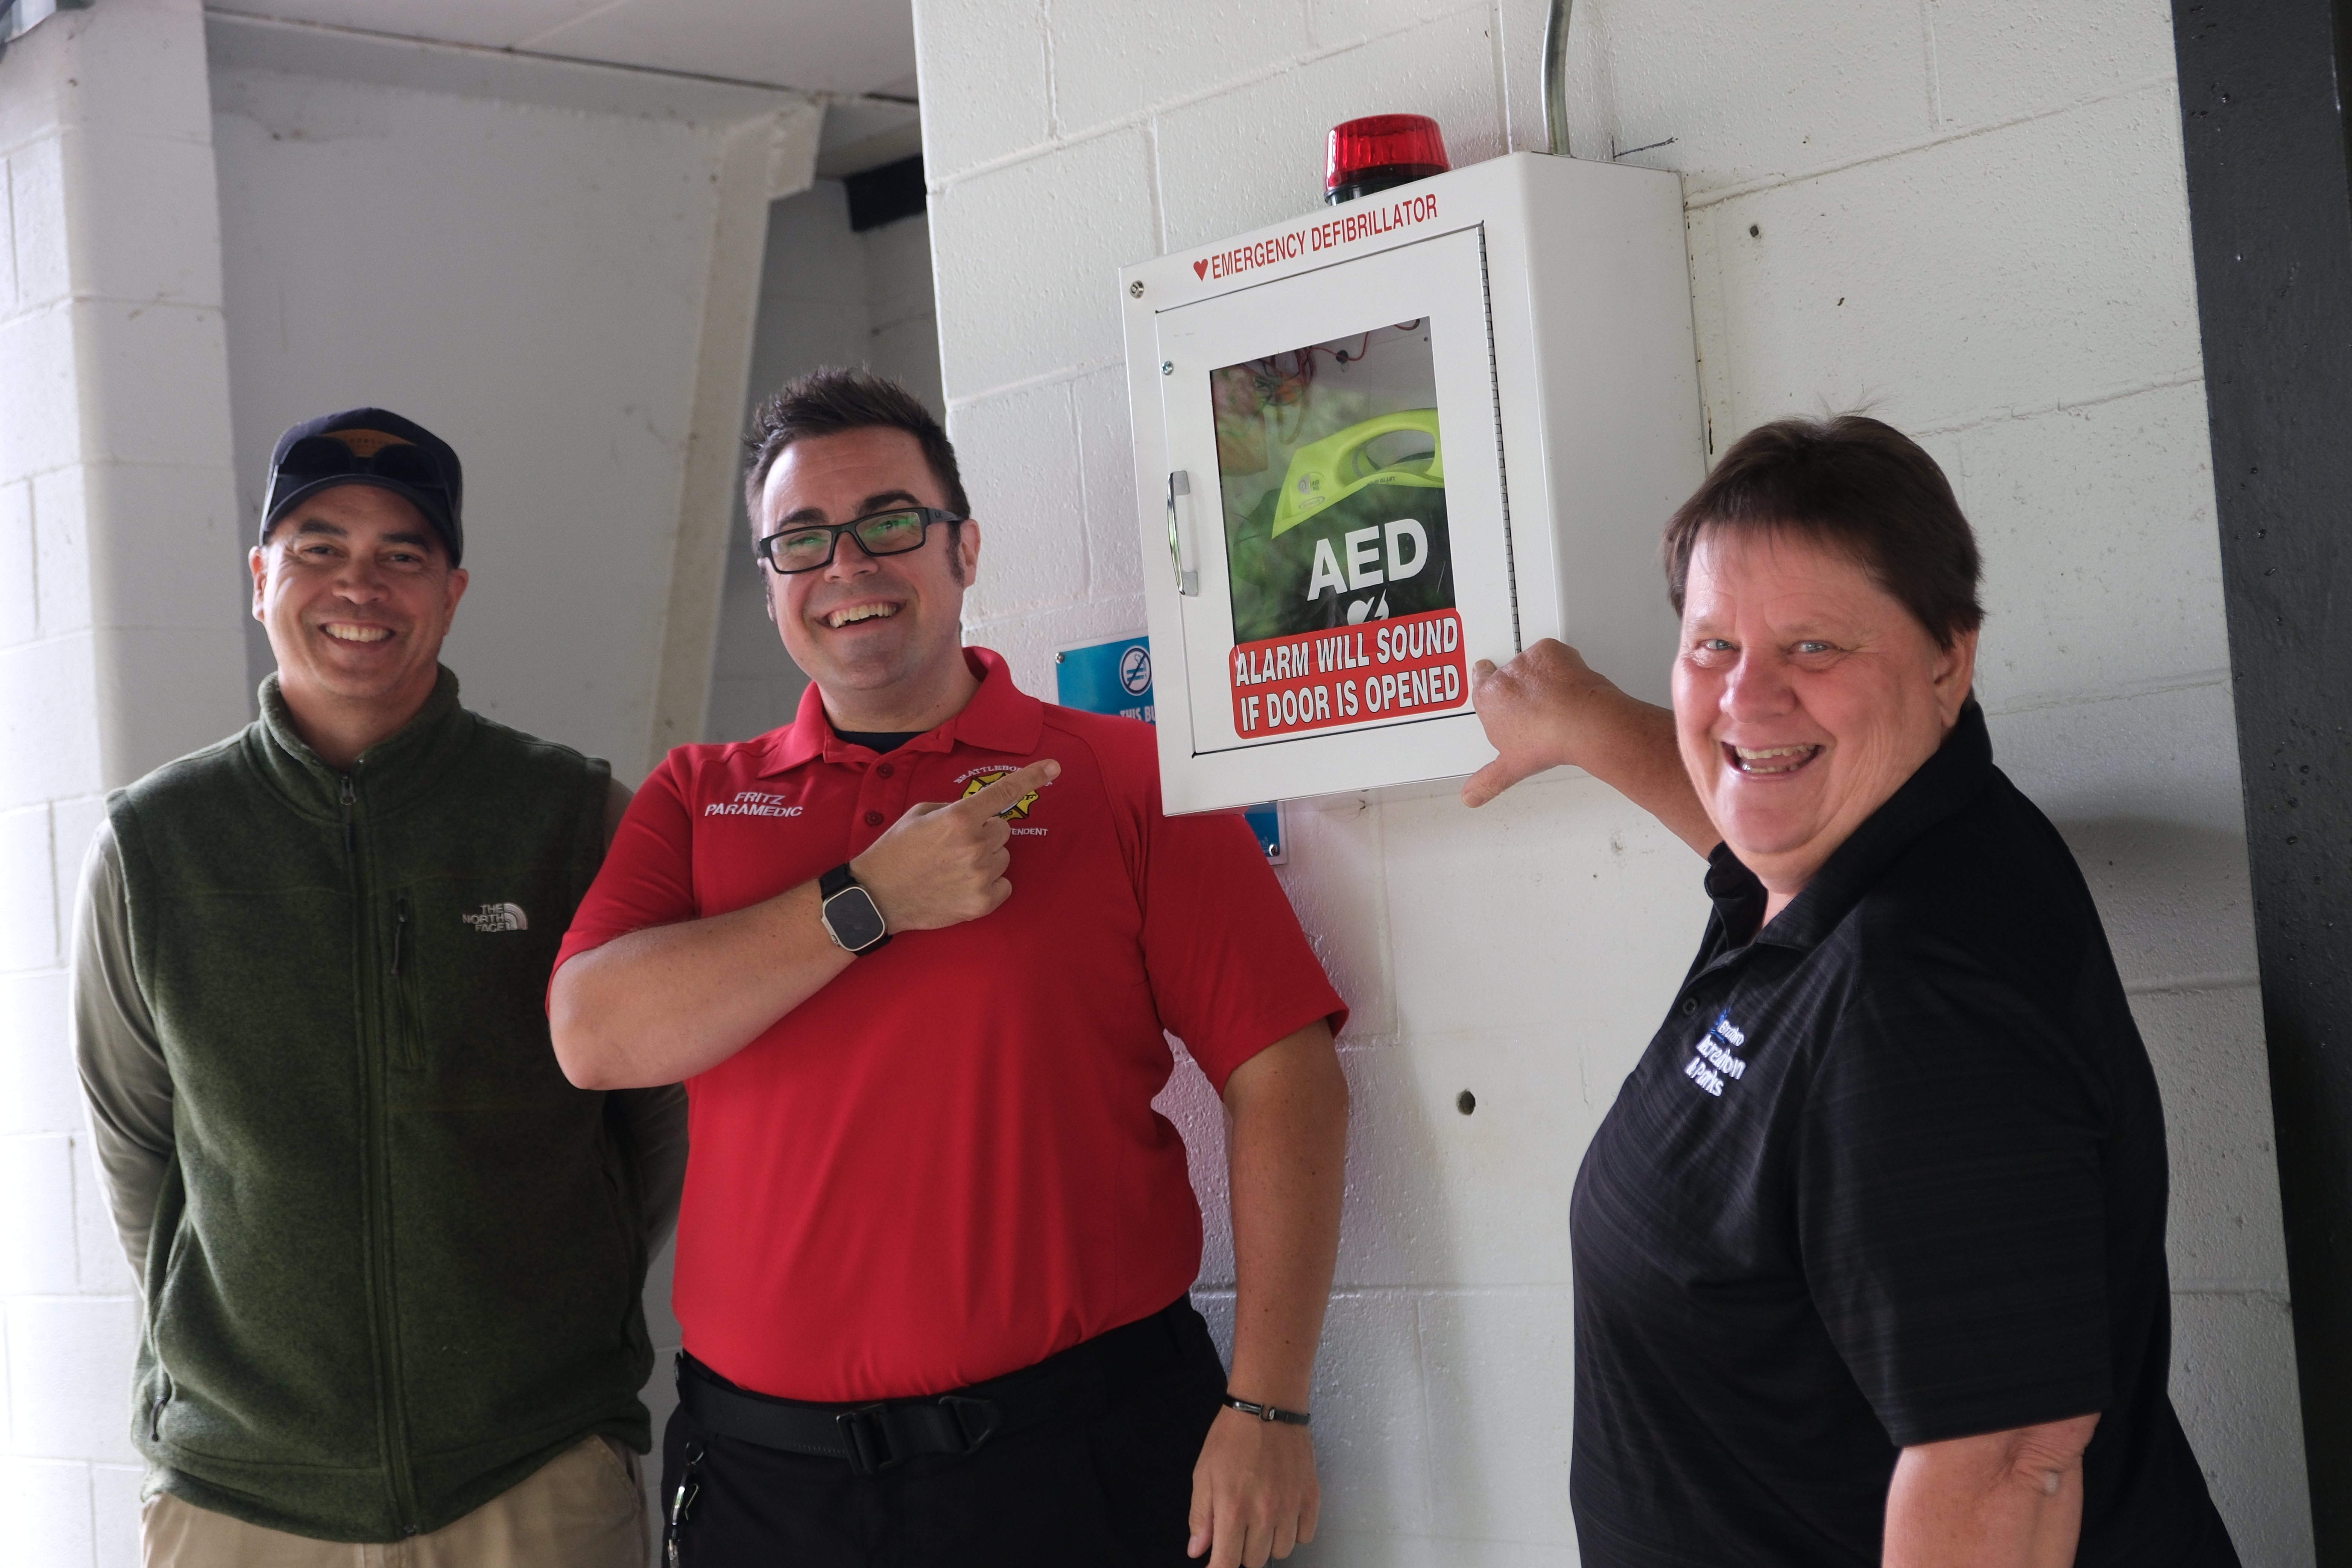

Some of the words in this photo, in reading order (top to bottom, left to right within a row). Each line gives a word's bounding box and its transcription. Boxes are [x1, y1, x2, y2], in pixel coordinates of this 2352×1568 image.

[1212, 230, 1306, 280] EMERGENCY
[1311, 193, 1438, 251] DEFIBRILLATOR
[1307, 518, 1428, 601] AED
[1236, 642, 1309, 687] ALARM
[1315, 632, 1370, 674] WILL
[1377, 617, 1458, 665] SOUND
[1240, 695, 1260, 732] IF
[1266, 685, 1331, 728] DOOR
[1336, 680, 1359, 717] IS
[1365, 665, 1460, 714] OPENED
[734, 792, 786, 805] FRITZ
[704, 802, 804, 817] PARAMEDIC
[479, 904, 504, 914] THE
[462, 913, 504, 924] NORTH
[475, 923, 505, 933] FACE
